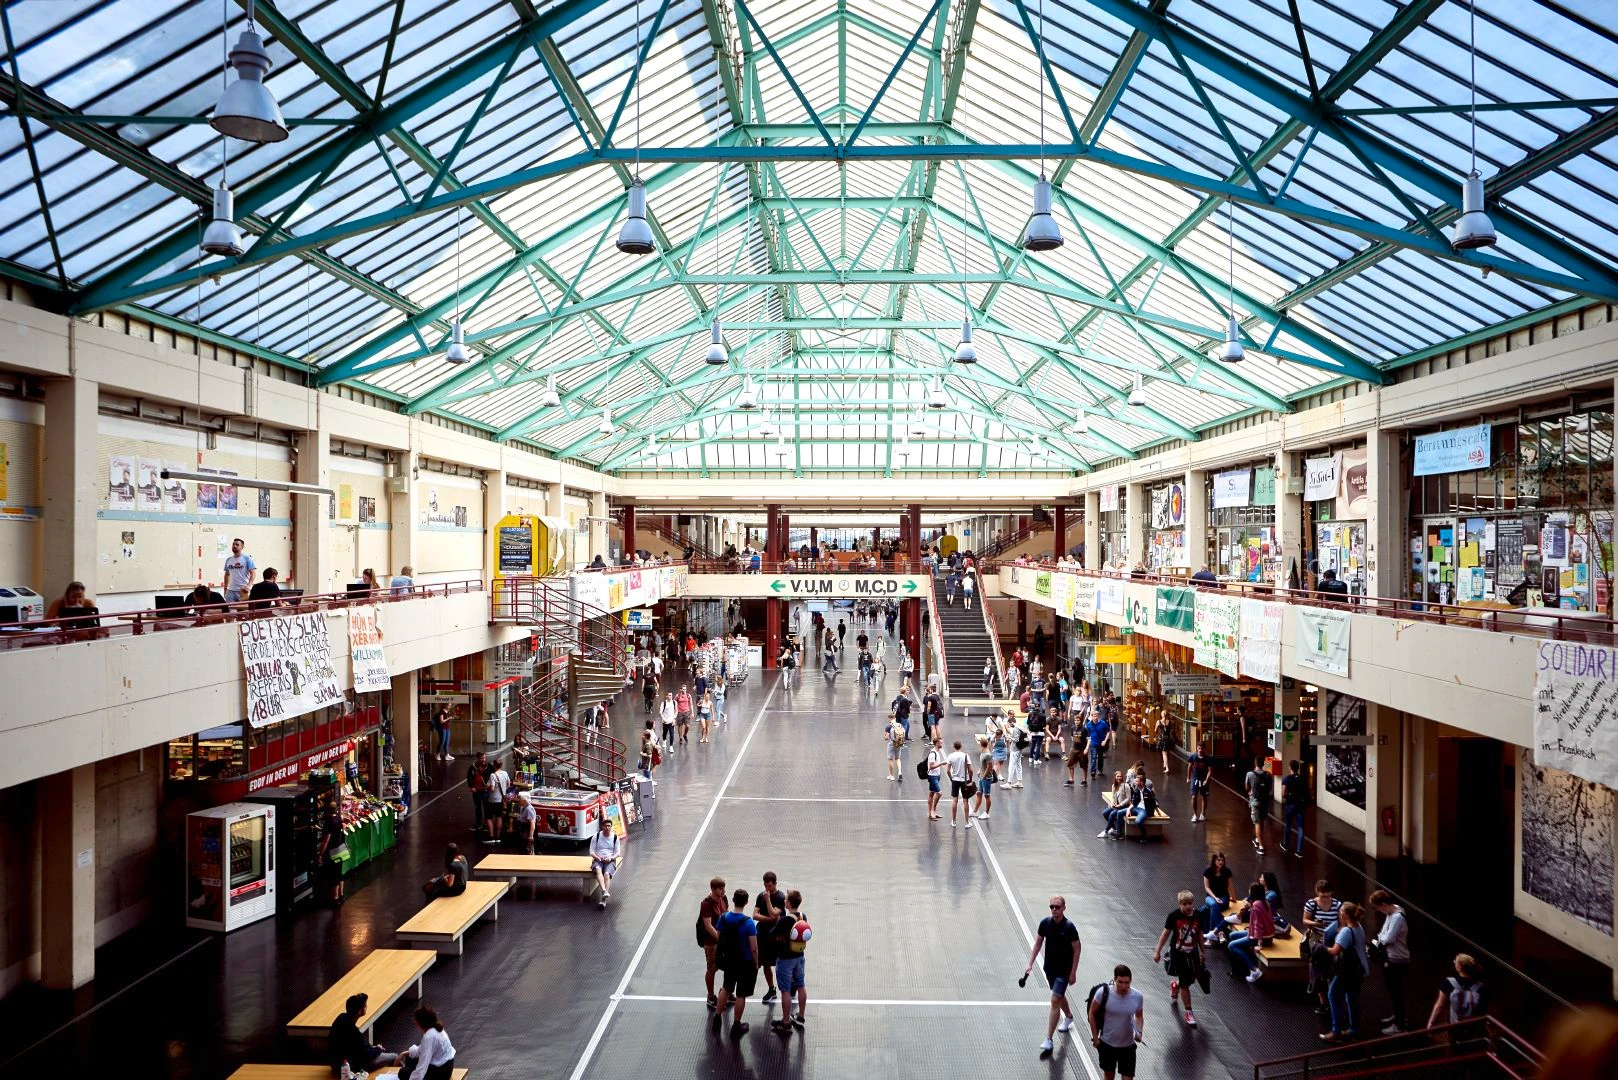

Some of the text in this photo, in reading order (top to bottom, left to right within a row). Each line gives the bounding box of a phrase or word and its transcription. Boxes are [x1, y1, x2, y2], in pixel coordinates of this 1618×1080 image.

[855, 579, 898, 596] M,C,D
[240, 612, 327, 644] POETRY SLAM
[1539, 684, 1555, 700] mit
[252, 698, 268, 722] 18
[328, 746, 339, 758] DER
[1541, 738, 1597, 761] in Frankreich
[265, 771, 274, 785] IN
[274, 767, 287, 781] DER
[287, 763, 298, 776] UNI
